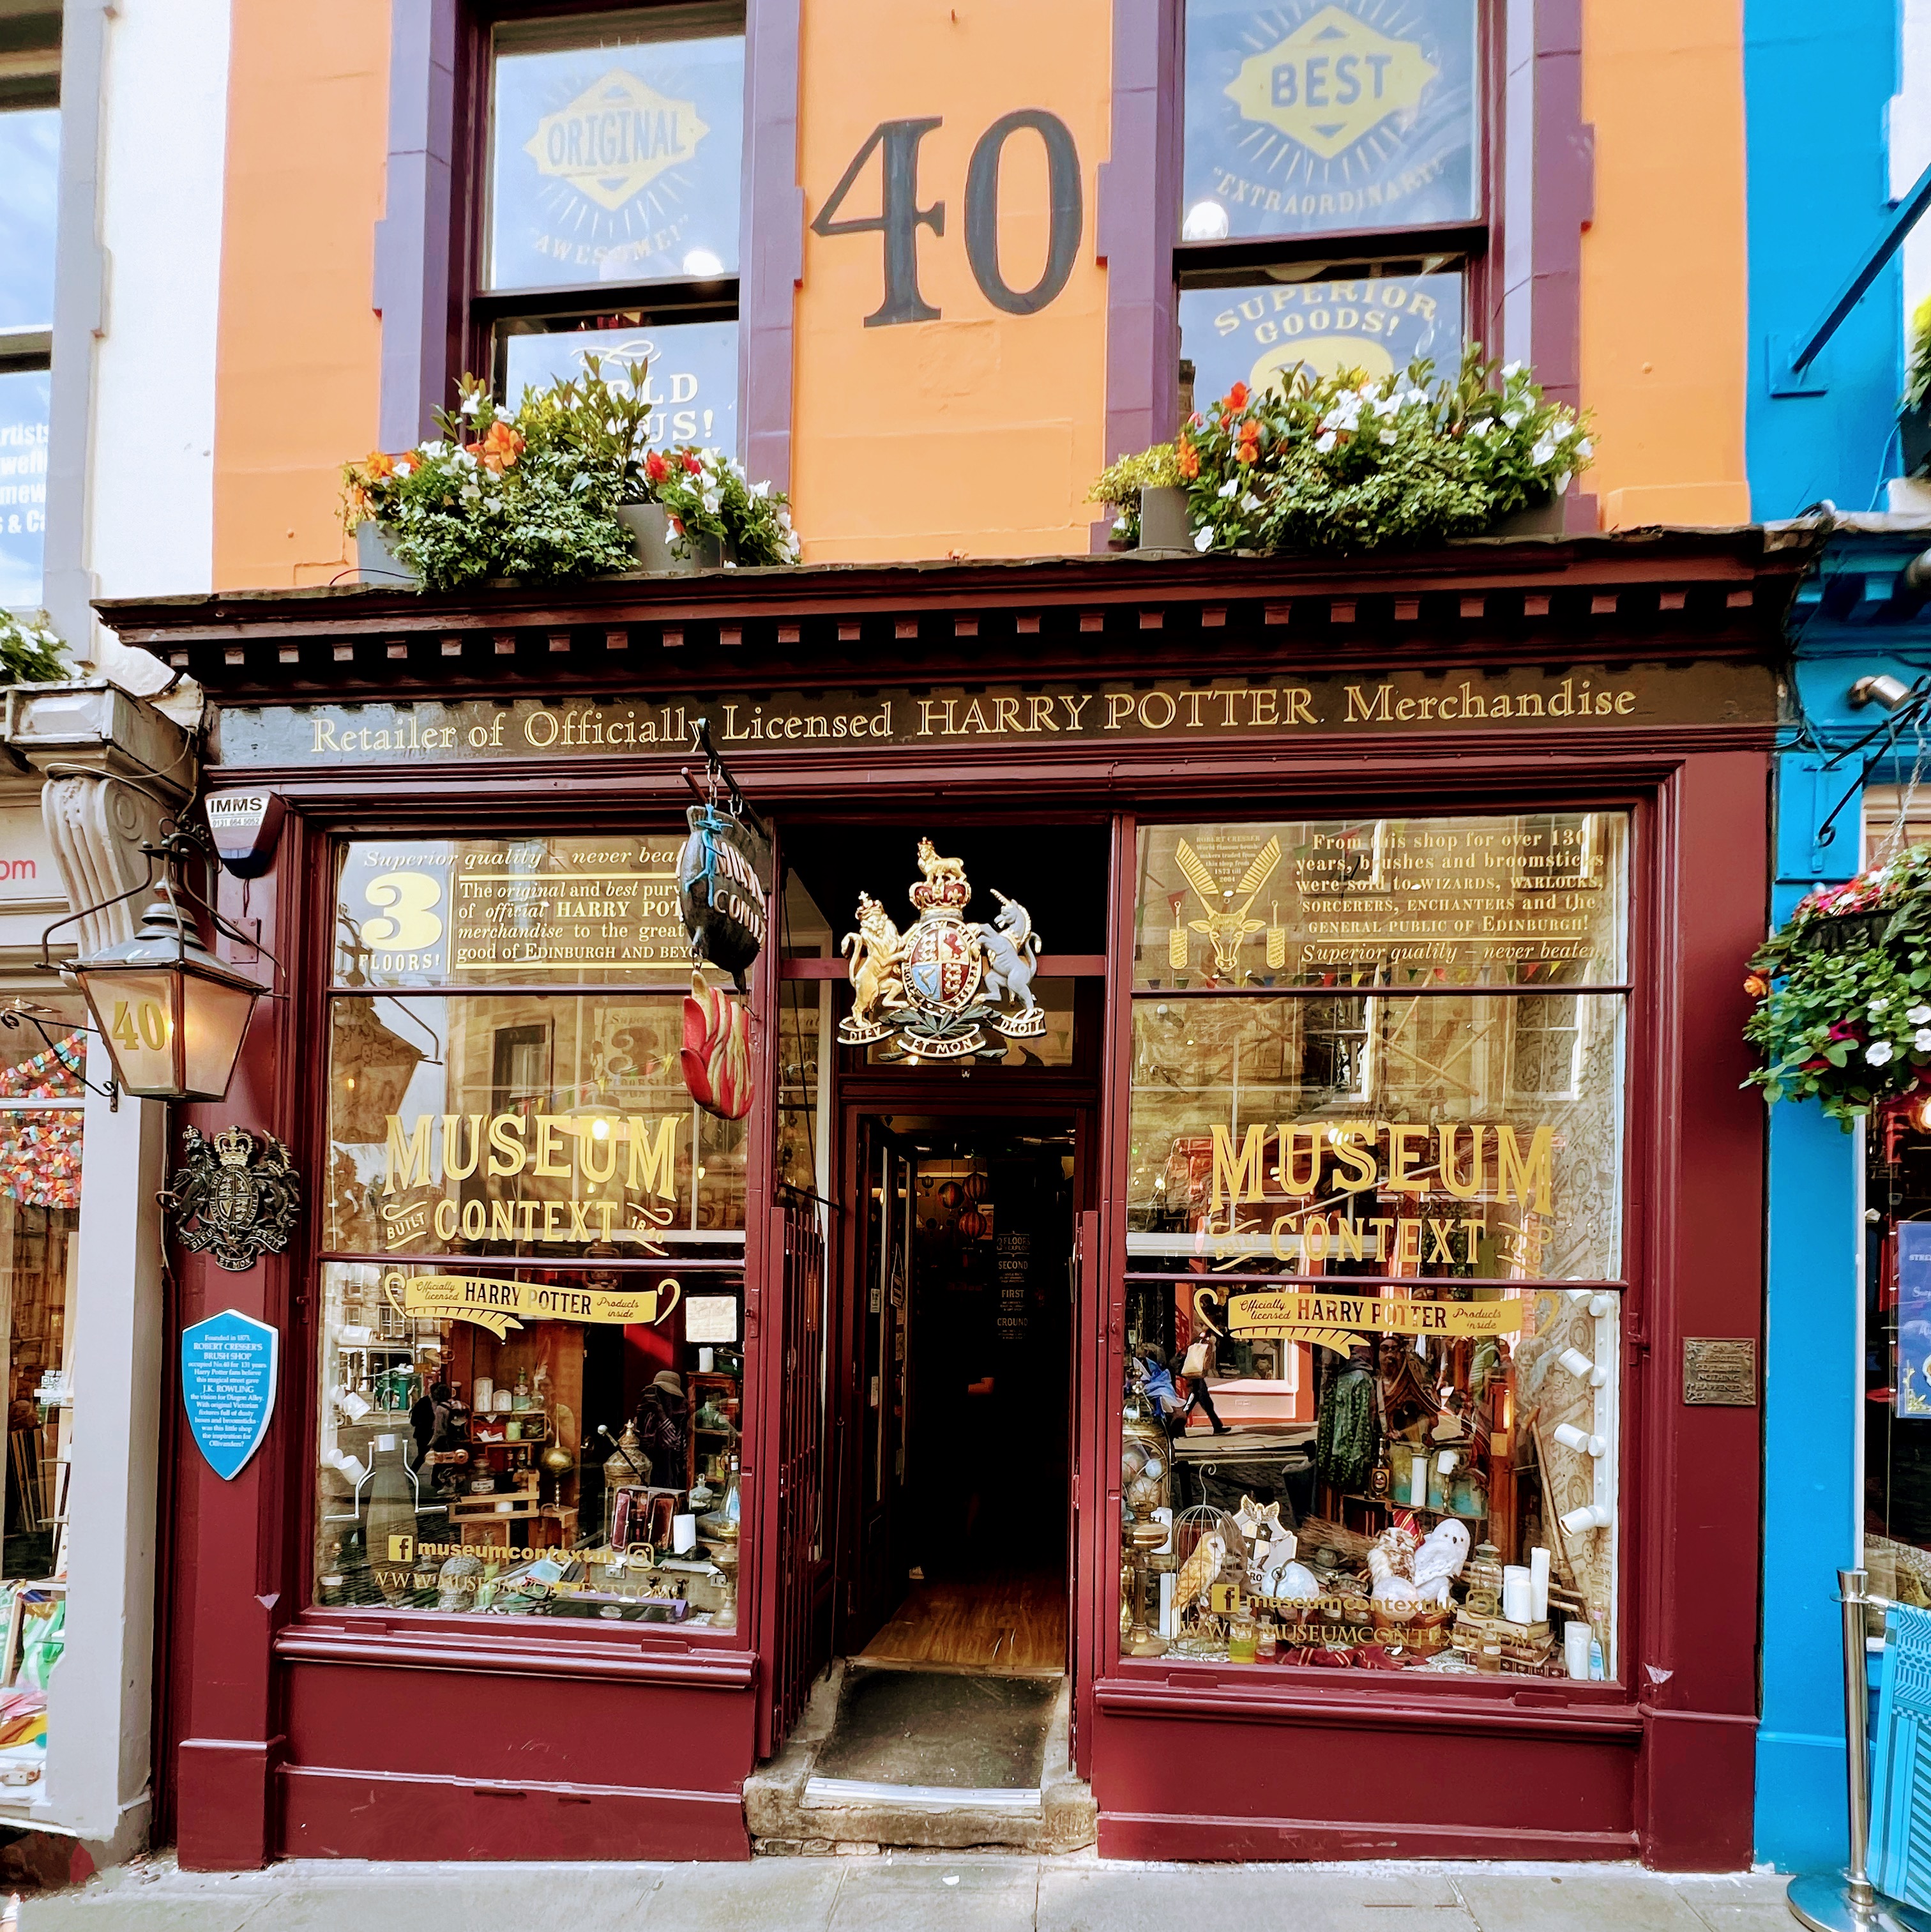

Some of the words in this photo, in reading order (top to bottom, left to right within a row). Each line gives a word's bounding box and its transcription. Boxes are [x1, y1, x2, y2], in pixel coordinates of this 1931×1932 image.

[1271, 55, 1392, 108] BEST
[546, 110, 687, 167] ORIGINAL
[810, 108, 1084, 328] 40
[1214, 281, 1437, 337] SUPERIOR
[1254, 308, 1400, 344] GOODS!
[310, 710, 457, 752] Retailer
[468, 711, 506, 748] of
[524, 706, 706, 752] Officially
[722, 701, 894, 741] Licensed
[916, 695, 1093, 736] HARRY
[1343, 677, 1637, 723] Merchandise
[211, 798, 262, 813] IMMS
[1313, 834, 1361, 850] From
[1413, 832, 1458, 851] shop
[1466, 832, 1494, 847] for
[1501, 833, 1542, 847] over
[1552, 829, 1585, 846] 130
[364, 850, 458, 871] Superior
[464, 849, 542, 870] quality
[572, 851, 632, 863] never
[1296, 856, 1352, 876] years,
[1359, 853, 1434, 870] bushes
[1442, 853, 1476, 869] and
[460, 883, 492, 898] The
[497, 882, 566, 904] original
[570, 885, 600, 897] and
[606, 881, 639, 897] best
[1296, 878, 1340, 892] were
[1347, 875, 1384, 890] sold
[1393, 876, 1411, 890] to
[1421, 878, 1501, 892] WIZARDS,
[1510, 876, 1604, 891] WARLOCKS,
[361, 872, 443, 952] 3
[458, 904, 476, 918] of
[485, 902, 545, 923] official
[556, 901, 630, 918] HARRY
[1302, 899, 1399, 915] SORCERERS,
[1407, 898, 1515, 911] ENCHANTERS
[1522, 894, 1556, 909] and
[1566, 894, 1596, 910] the
[458, 922, 563, 939] merchandise
[574, 926, 591, 938] to
[602, 922, 628, 938] the
[1308, 921, 1381, 934] GENERAL
[1388, 920, 1447, 932] PUBLIC
[1454, 919, 1474, 931] OF
[358, 954, 441, 972] FLOORS!
[457, 943, 496, 963] good
[502, 943, 519, 959] of
[621, 946, 655, 959] AND
[1301, 943, 1386, 965] Superior
[1390, 942, 1458, 964] quality
[1483, 945, 1534, 959] never
[112, 1000, 165, 1051] 40
[912, 1037, 926, 1049] ET
[935, 1037, 973, 1054] MON
[382, 1113, 679, 1202] MUSEUM
[1208, 1124, 1554, 1217] MUSEUM
[386, 1212, 426, 1240] BUILT
[434, 1199, 618, 1244] CONTEXT
[630, 1215, 665, 1245] 1840
[1271, 1217, 1486, 1265] CONTEXT
[998, 1261, 1028, 1270] SECOND
[415, 1281, 457, 1293] Officially
[424, 1291, 460, 1301] licensed
[1001, 1289, 1025, 1298] FIRST
[465, 1281, 522, 1307] HARRY
[527, 1288, 592, 1316] POTTER
[596, 1296, 639, 1309] Products
[1239, 1299, 1287, 1313] Officially
[607, 1308, 635, 1319] inside
[1250, 1309, 1291, 1320] licensed
[1297, 1298, 1365, 1324] HARRY
[1371, 1300, 1447, 1329] POTTER
[1451, 1307, 1503, 1320] Products
[193, 1343, 223, 1351] ROBERT
[231, 1353, 252, 1361] SHOP
[216, 1385, 254, 1394] ROWLING
[227, 1394, 247, 1402] Diagon
[211, 1401, 232, 1410] original
[238, 1410, 254, 1418] dusty
[239, 1425, 253, 1434] shop
